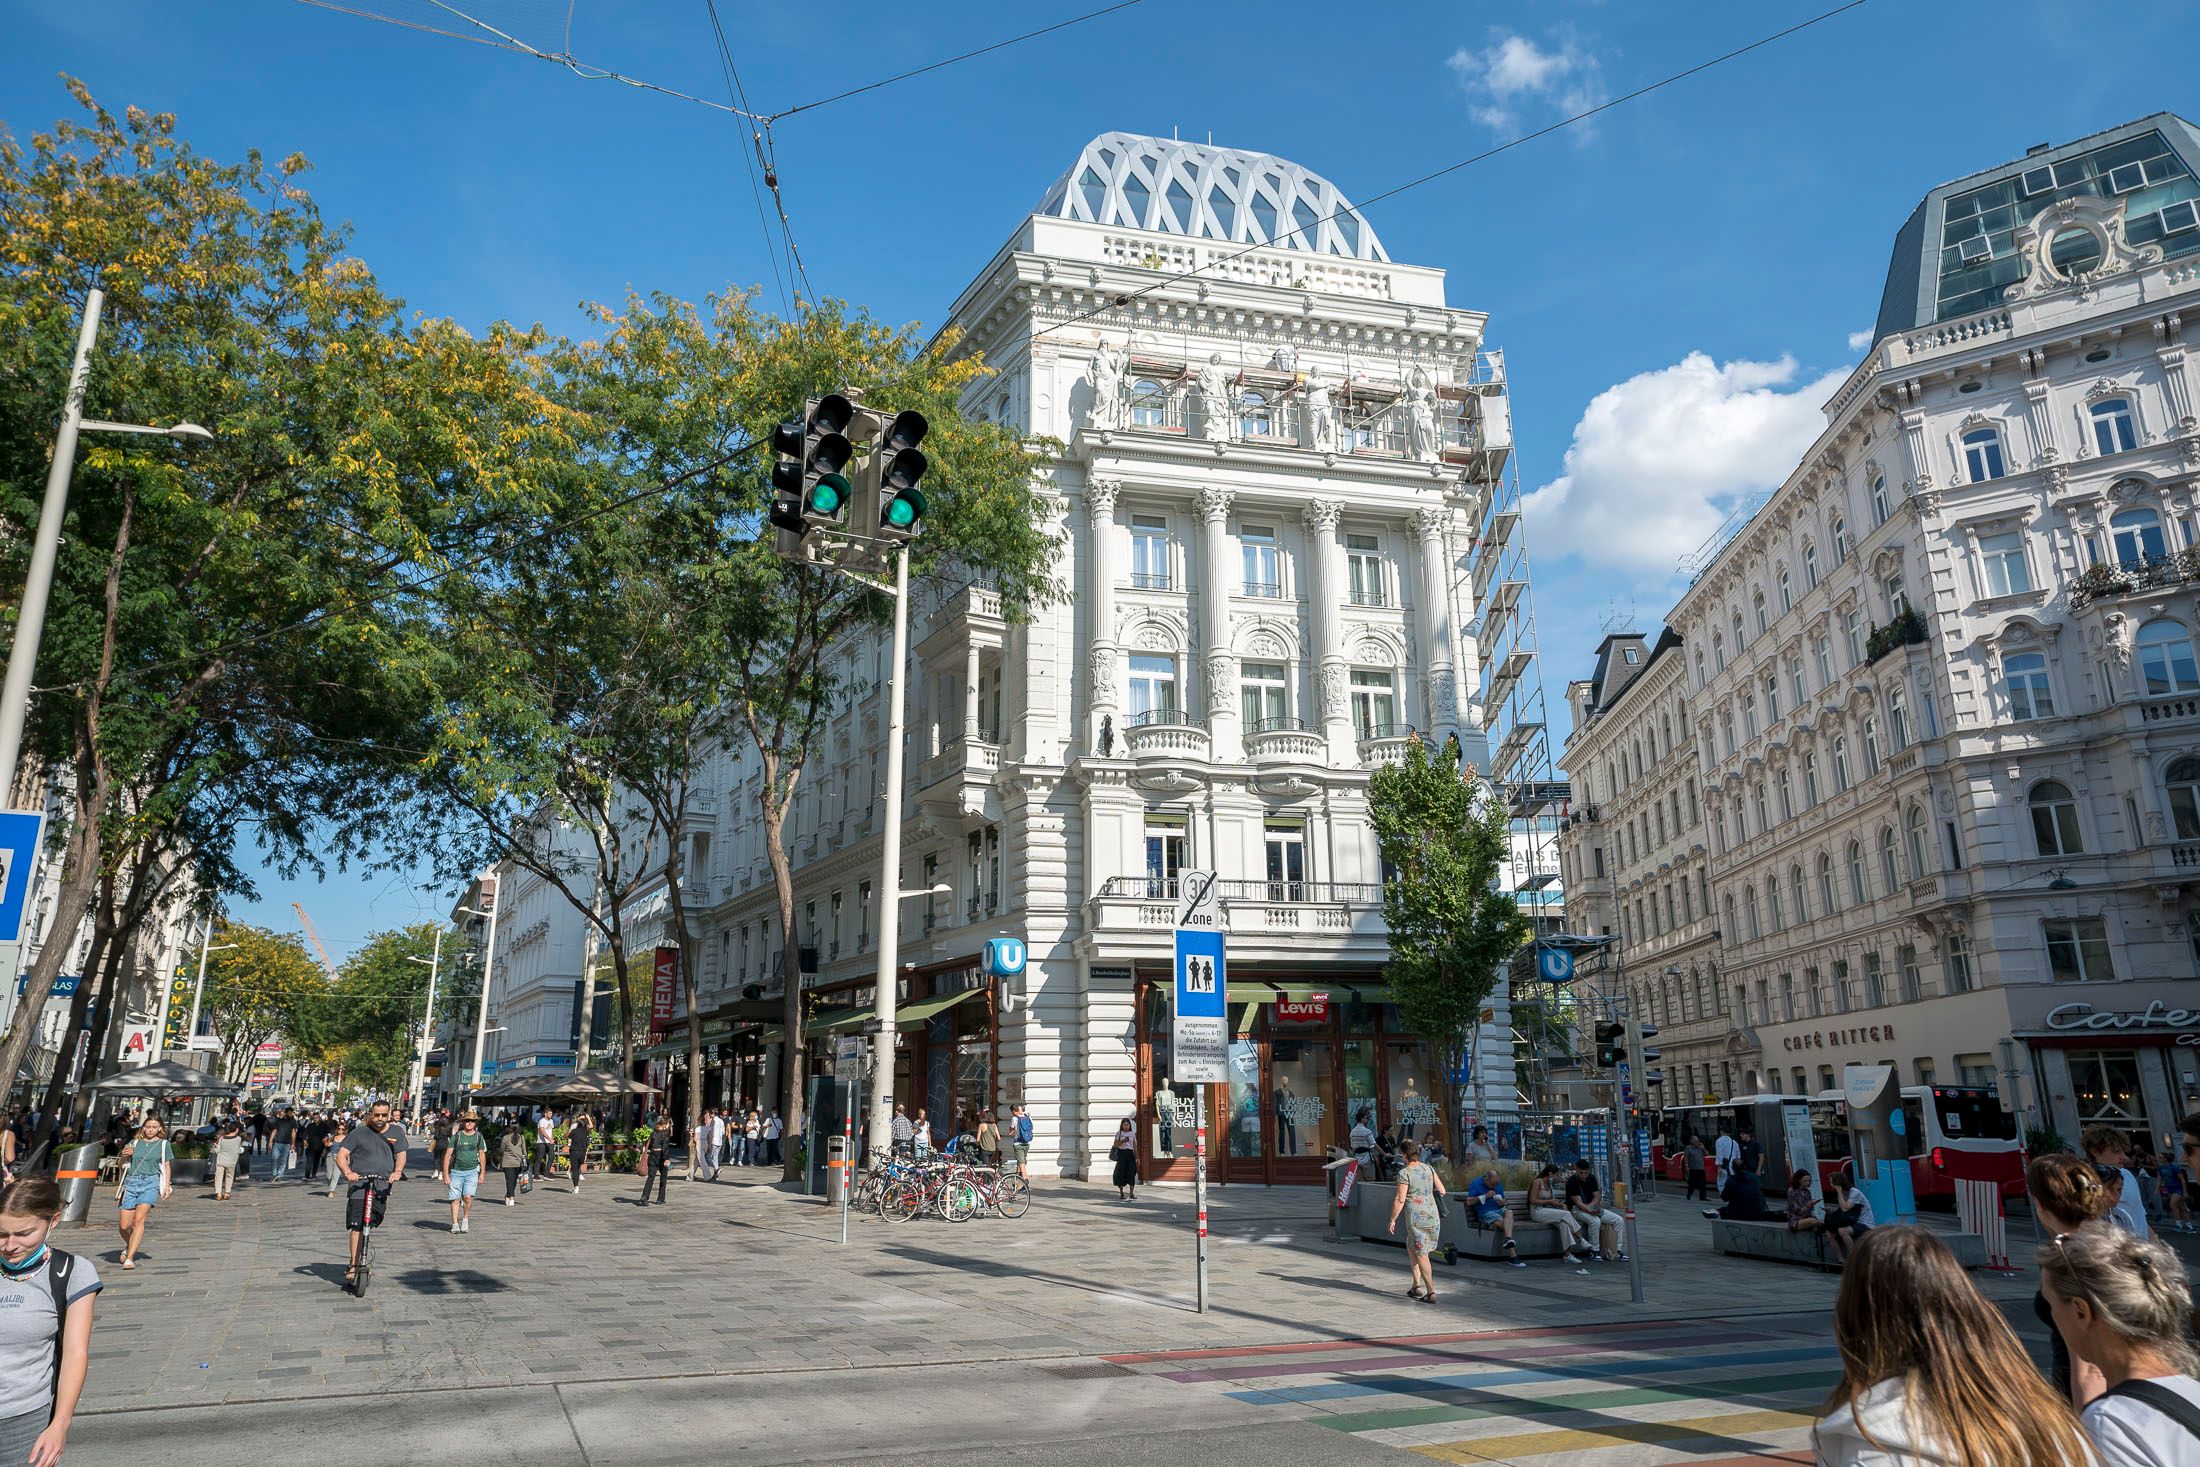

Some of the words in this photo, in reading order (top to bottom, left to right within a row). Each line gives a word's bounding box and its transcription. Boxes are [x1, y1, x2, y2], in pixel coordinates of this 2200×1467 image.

[1189, 879, 1207, 900] 30
[1002, 945, 1021, 969] U
[1546, 954, 1568, 976] U
[655, 962, 673, 1018] HEMA
[127, 1029, 154, 1052] A1
[1828, 1024, 1896, 1047] RITTER
[1284, 1111, 1324, 1119] WASTE
